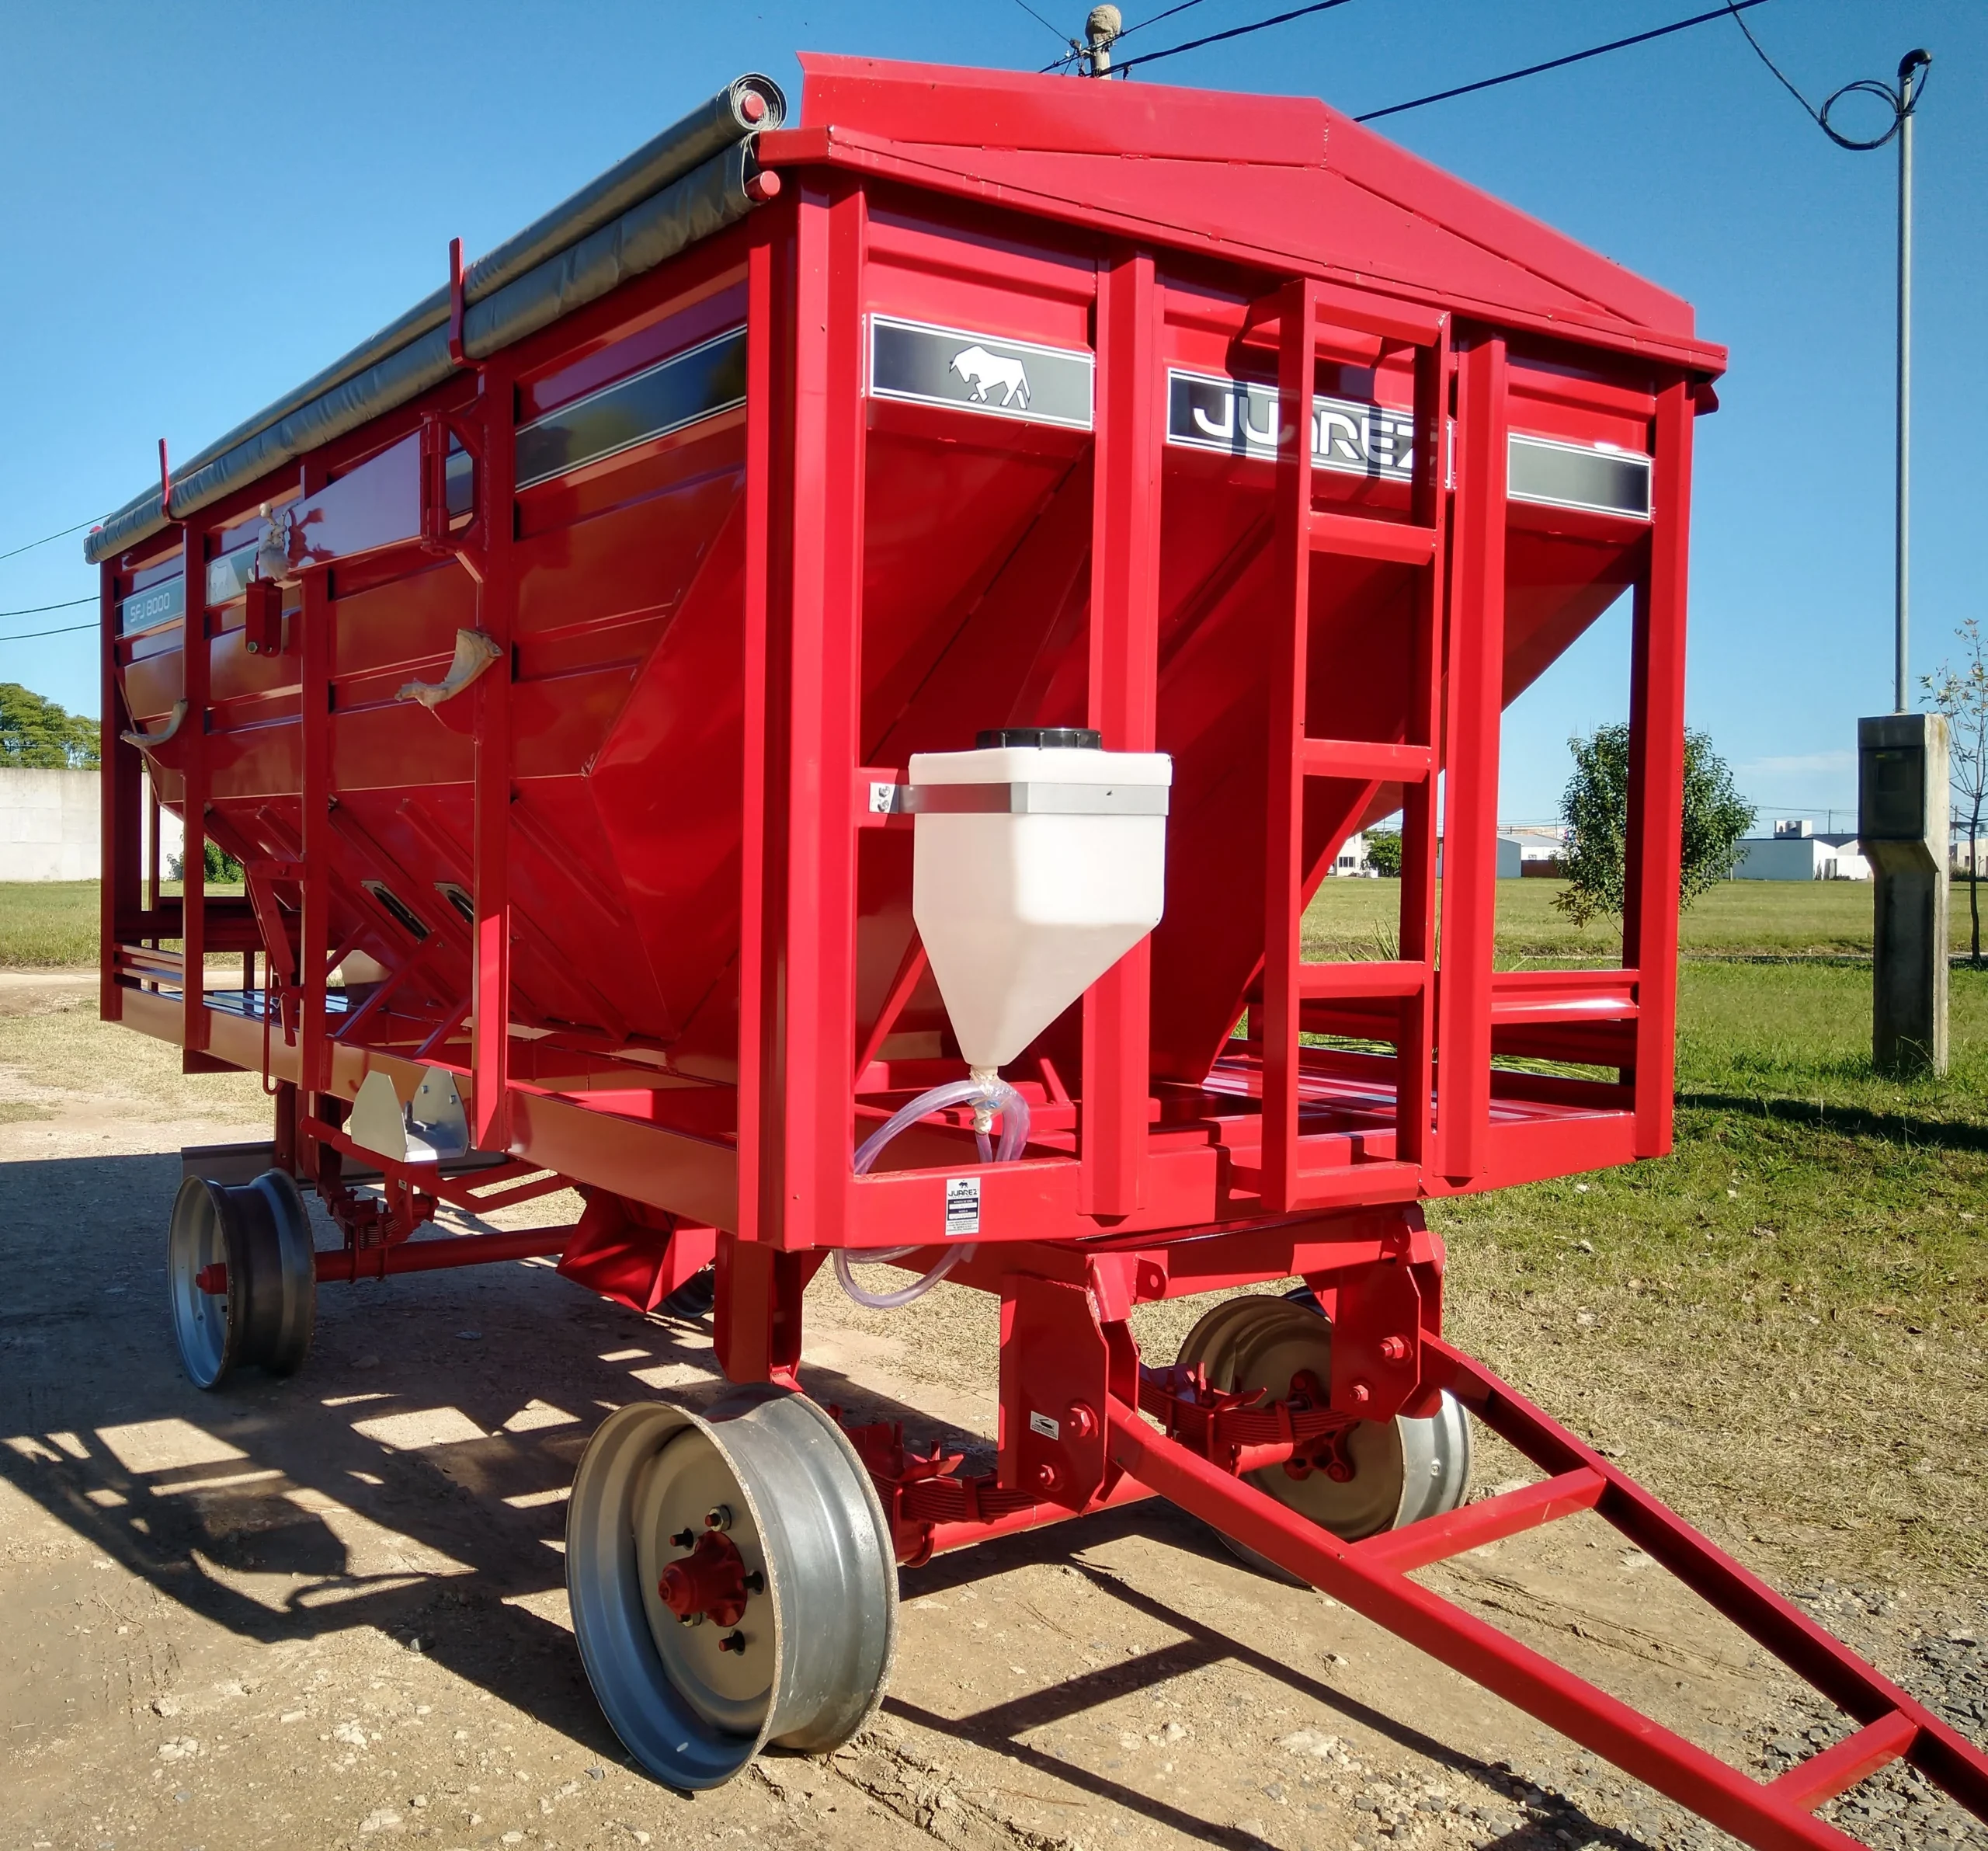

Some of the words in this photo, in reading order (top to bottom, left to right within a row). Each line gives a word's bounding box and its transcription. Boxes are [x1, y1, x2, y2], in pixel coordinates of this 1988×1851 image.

[1193, 392, 1413, 469] JUREZ
[130, 602, 145, 623] SFJ
[146, 592, 170, 617] 8000
[948, 1188, 978, 1197] JUAREZ
